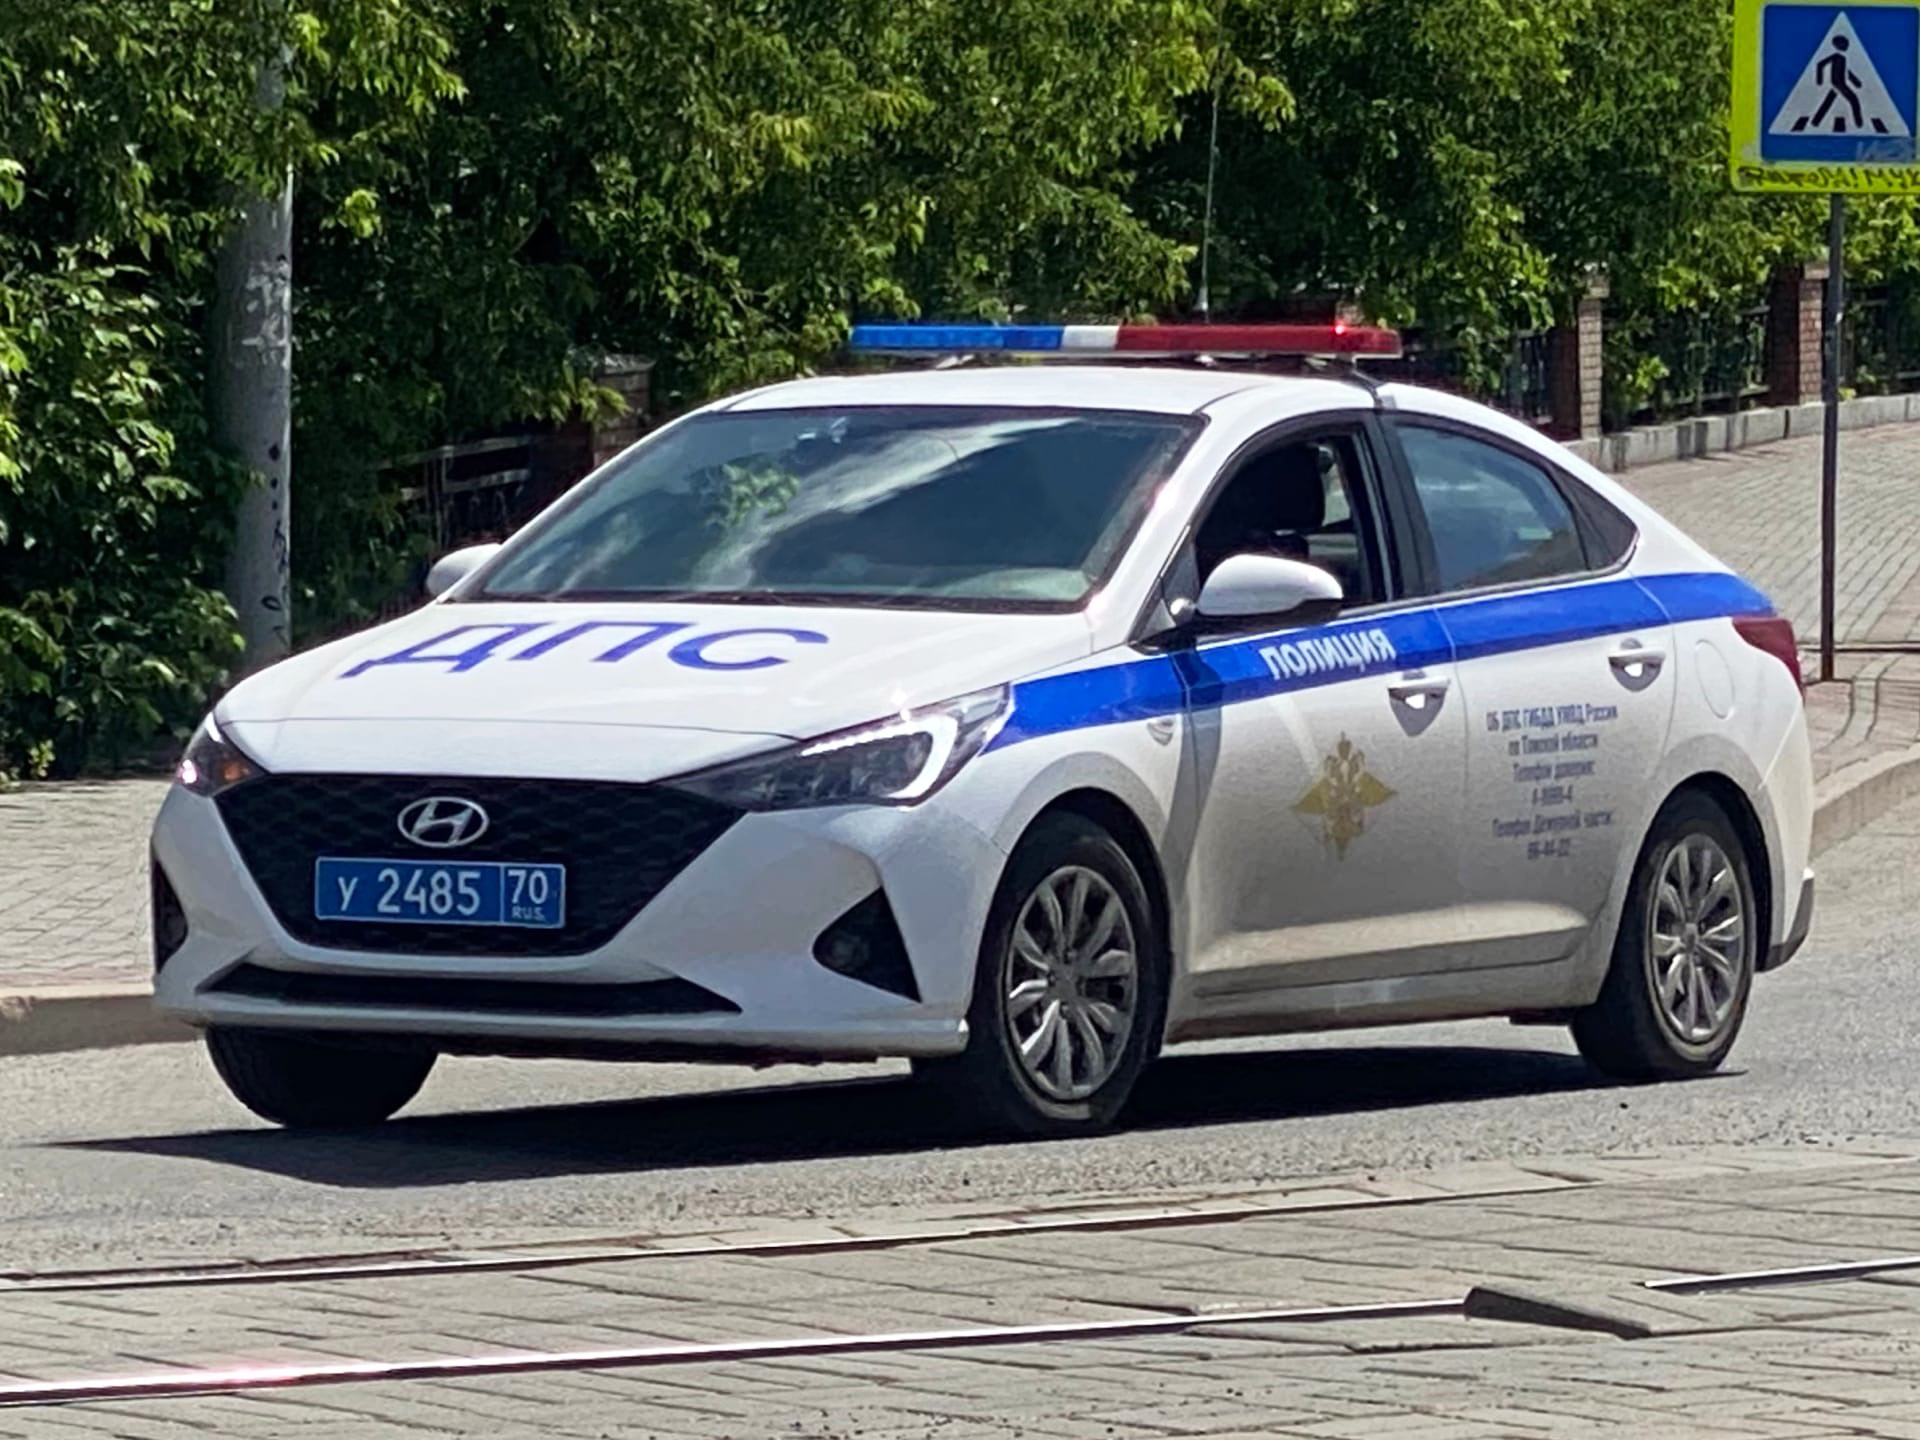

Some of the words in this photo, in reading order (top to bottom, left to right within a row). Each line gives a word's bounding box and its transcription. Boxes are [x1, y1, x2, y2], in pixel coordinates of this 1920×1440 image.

[336, 621, 830, 679] ДПС
[1258, 628, 1397, 680] ПОЛИЦИЯ
[377, 868, 481, 915] 2485
[508, 869, 548, 904] 70
[512, 906, 545, 920] RUS
